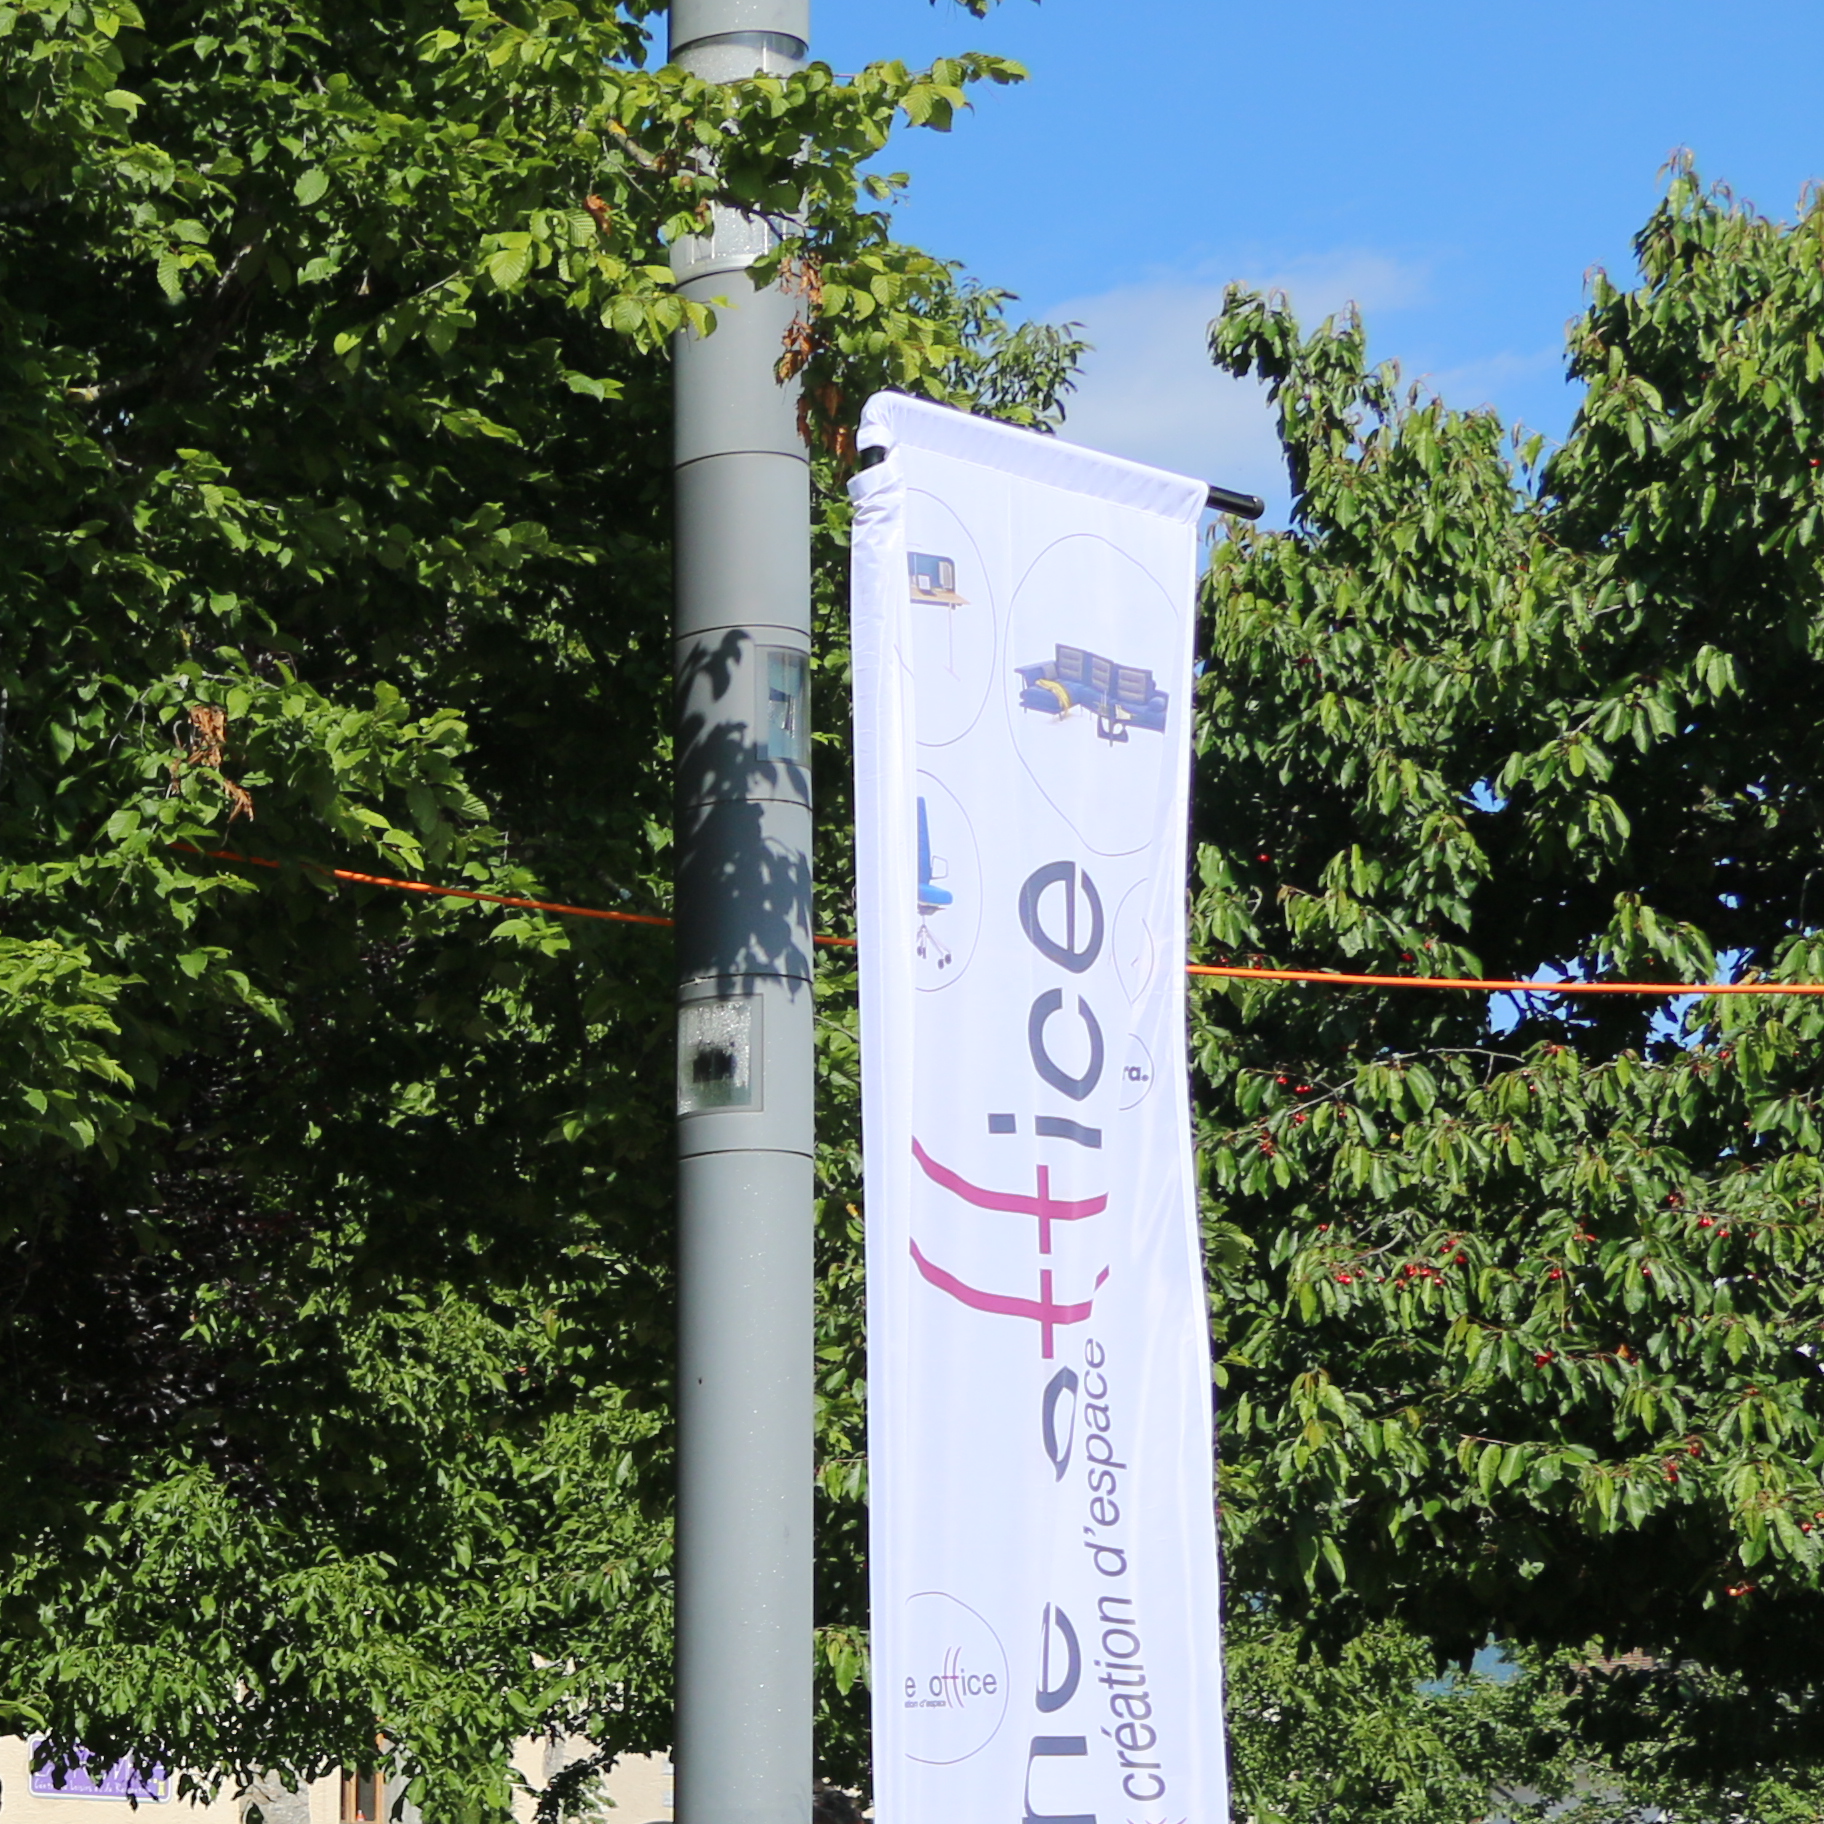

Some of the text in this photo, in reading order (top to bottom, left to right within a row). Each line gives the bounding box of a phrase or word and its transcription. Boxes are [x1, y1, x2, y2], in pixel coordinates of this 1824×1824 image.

[929, 1646, 998, 1709] office
[1082, 1337, 1168, 1803] création d'espace
